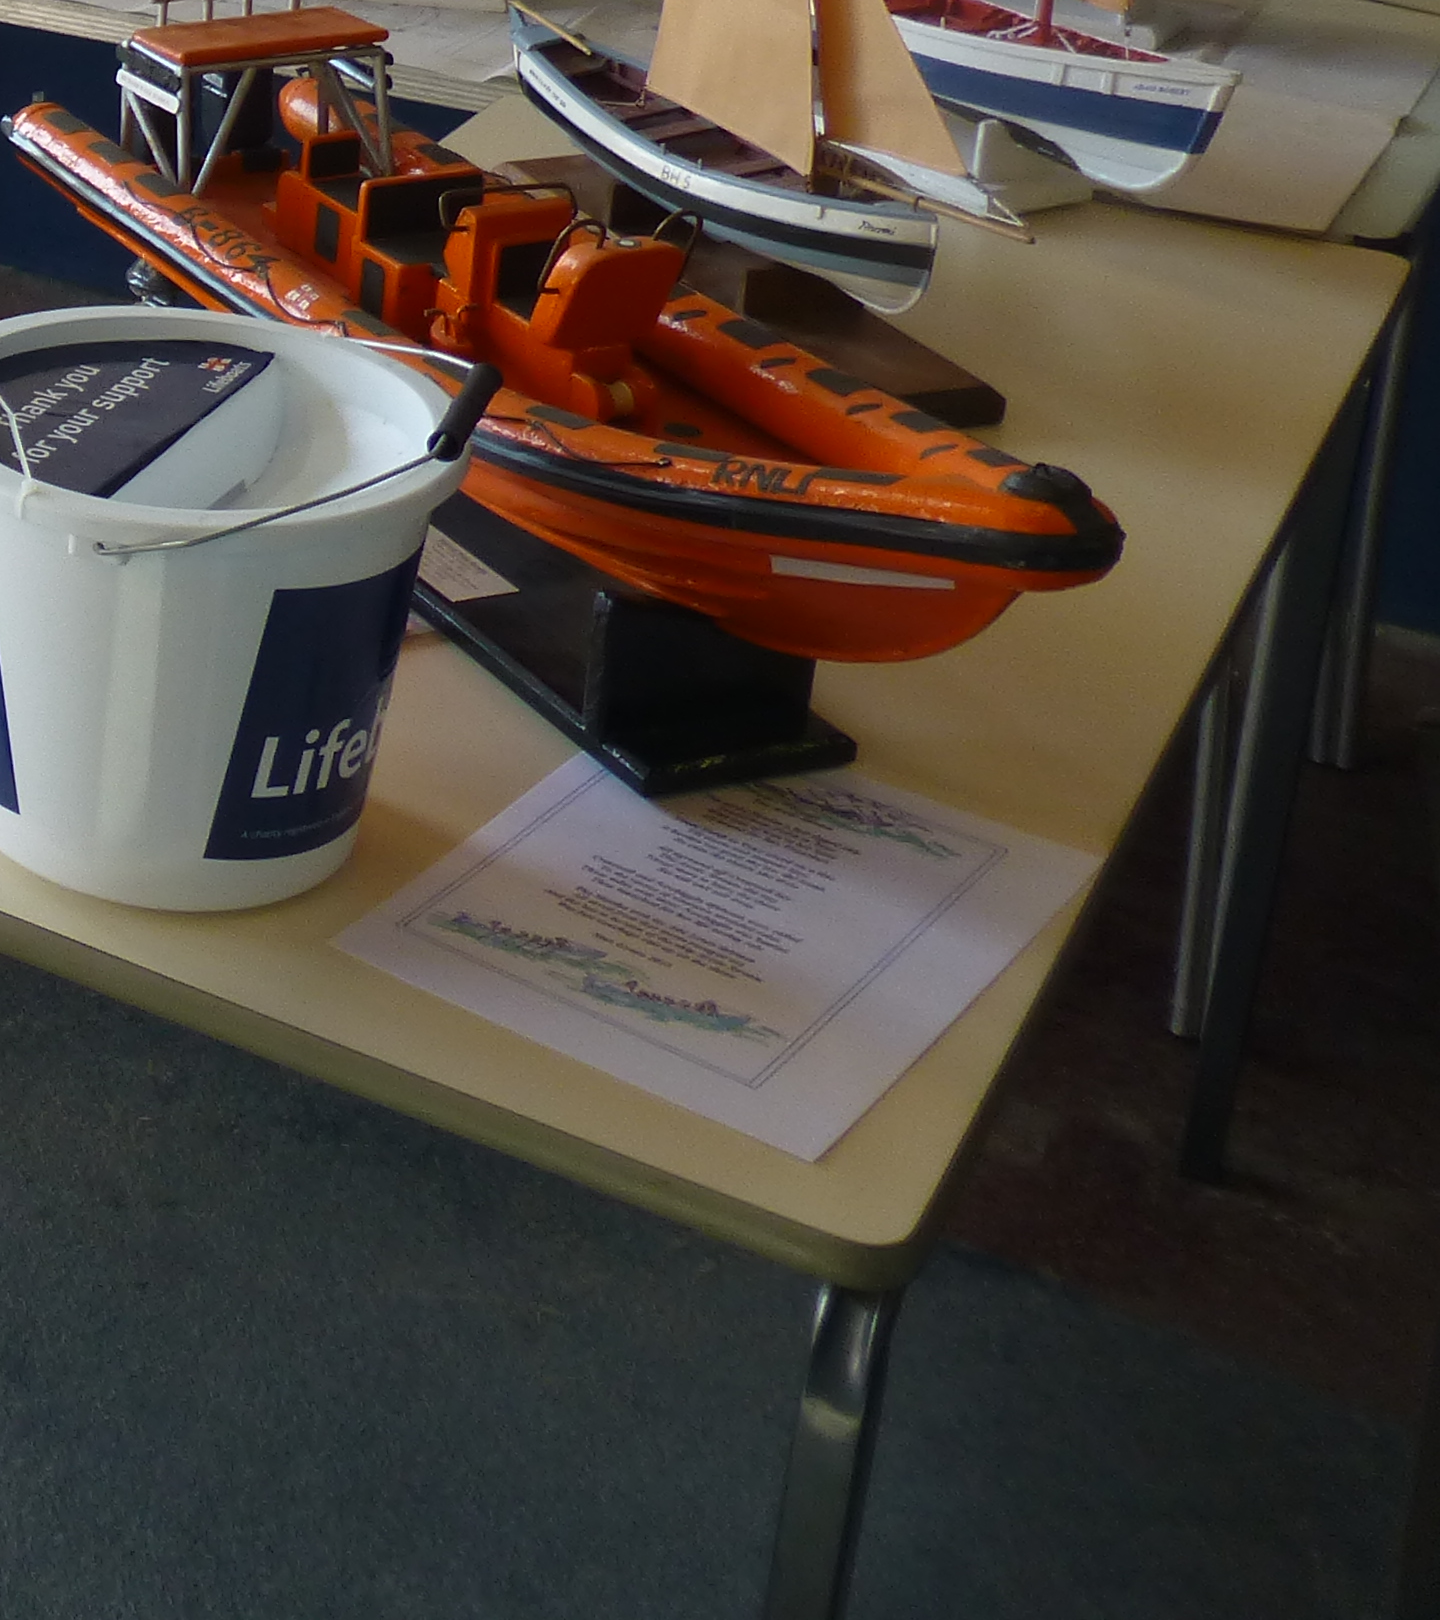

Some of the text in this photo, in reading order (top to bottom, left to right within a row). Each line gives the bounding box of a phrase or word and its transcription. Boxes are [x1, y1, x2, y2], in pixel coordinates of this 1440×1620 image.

[661, 164, 682, 184] BH
[62, 364, 102, 392] you
[202, 360, 253, 395] Lifeboats
[12, 356, 171, 464] for your support
[710, 458, 812, 496] RNLI
